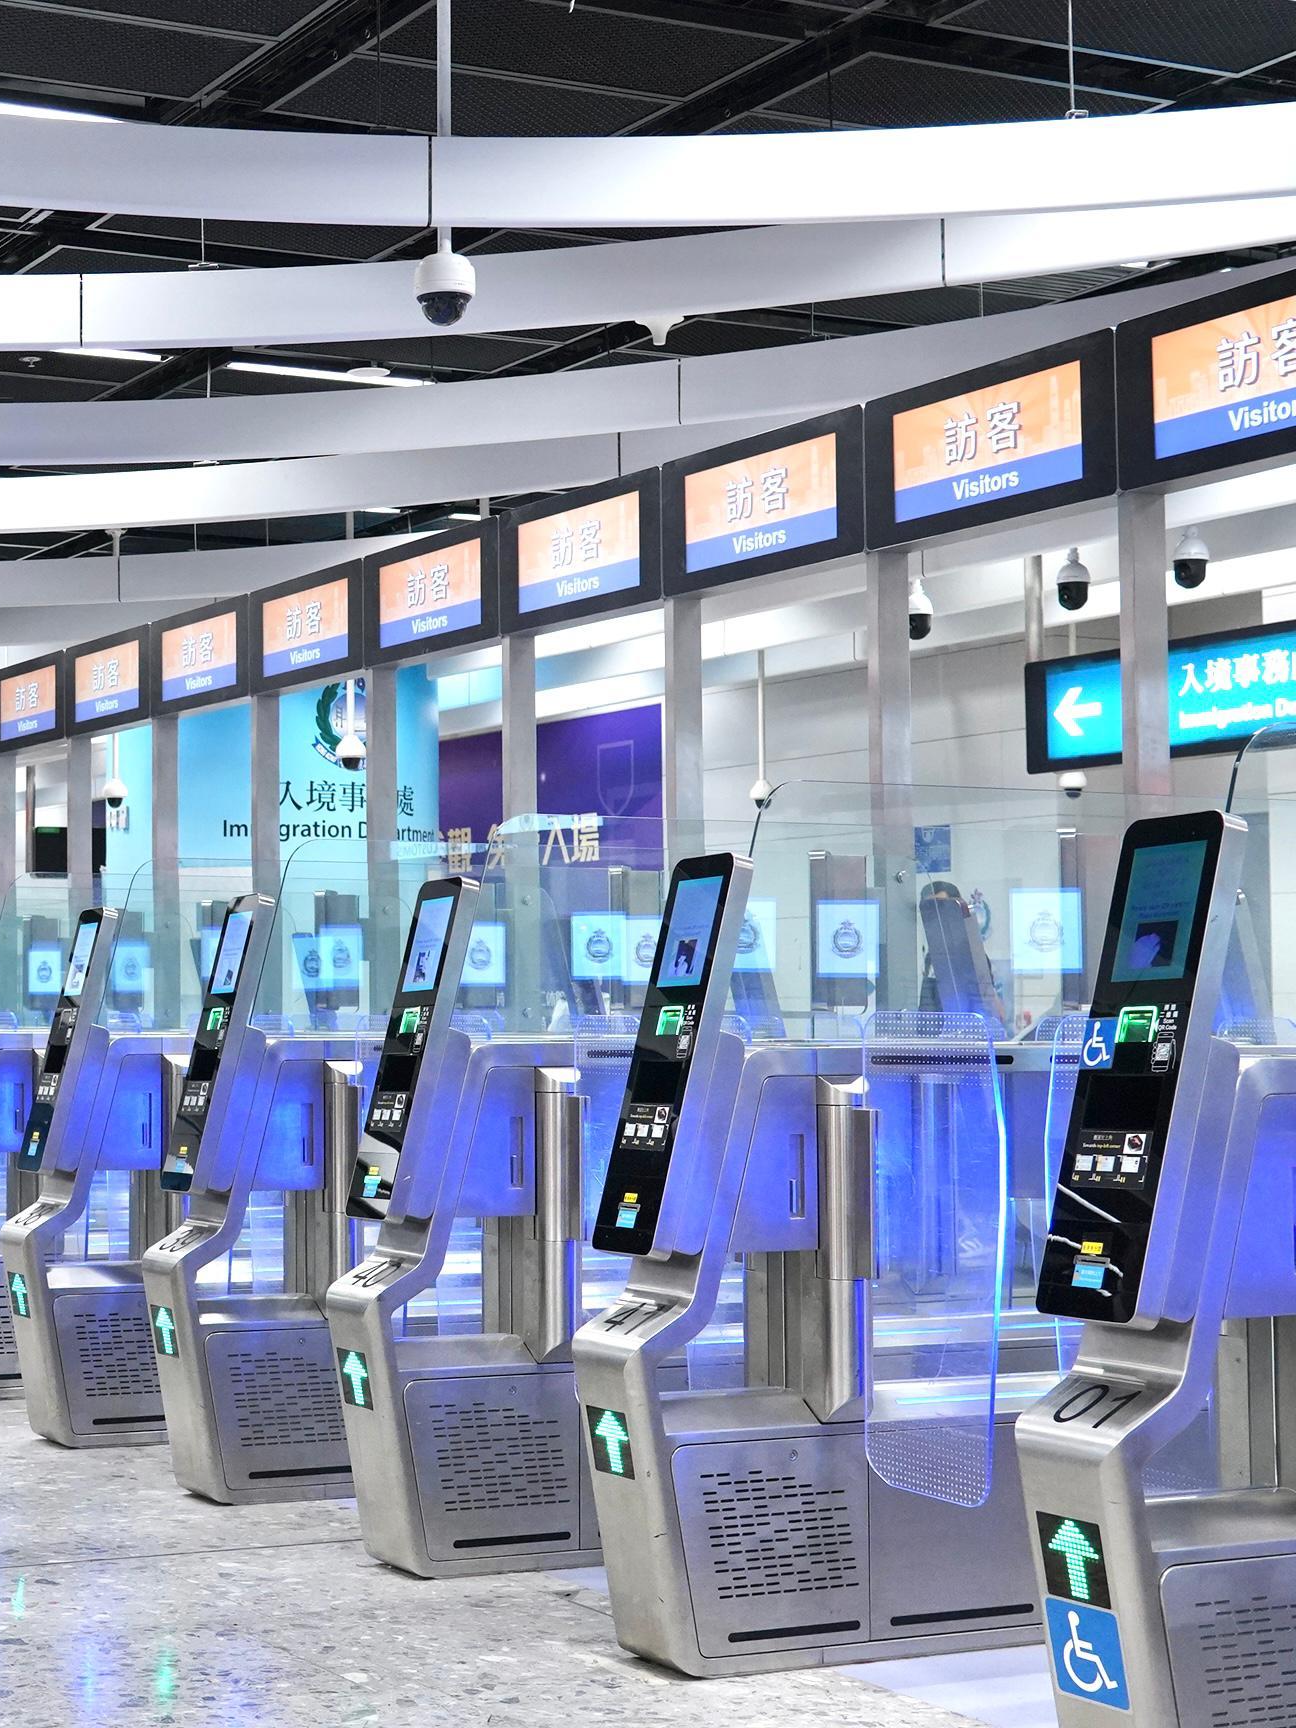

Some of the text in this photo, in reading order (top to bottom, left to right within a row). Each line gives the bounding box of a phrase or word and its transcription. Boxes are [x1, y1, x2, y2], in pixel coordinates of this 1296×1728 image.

[943, 401, 1022, 466] 訪客
[726, 465, 788, 523] 訪客
[952, 468, 1020, 501] Visitors
[550, 519, 602, 569] 訪客
[732, 527, 787, 555] Visitors
[406, 563, 450, 608] 訪客
[555, 575, 600, 598] Visitors
[285, 600, 321, 641] 訪客
[411, 613, 448, 635] Visitors
[181, 632, 215, 668] 訪客
[289, 644, 321, 665] Visitors
[92, 658, 121, 692] 訪客
[185, 673, 213, 692] Visitors
[1178, 648, 1296, 697] 入境事務
[15, 683, 40, 712] 訪客
[95, 695, 120, 713] Visitors
[17, 717, 38, 733] Visitors
[279, 780, 414, 817] 入境事處
[223, 819, 435, 842] Imgration Dartment
[15, 1203, 53, 1226] 38
[159, 1229, 202, 1253] 39
[352, 1260, 402, 1288] 40
[604, 1302, 666, 1335] 41
[1053, 1384, 1143, 1429] 01
